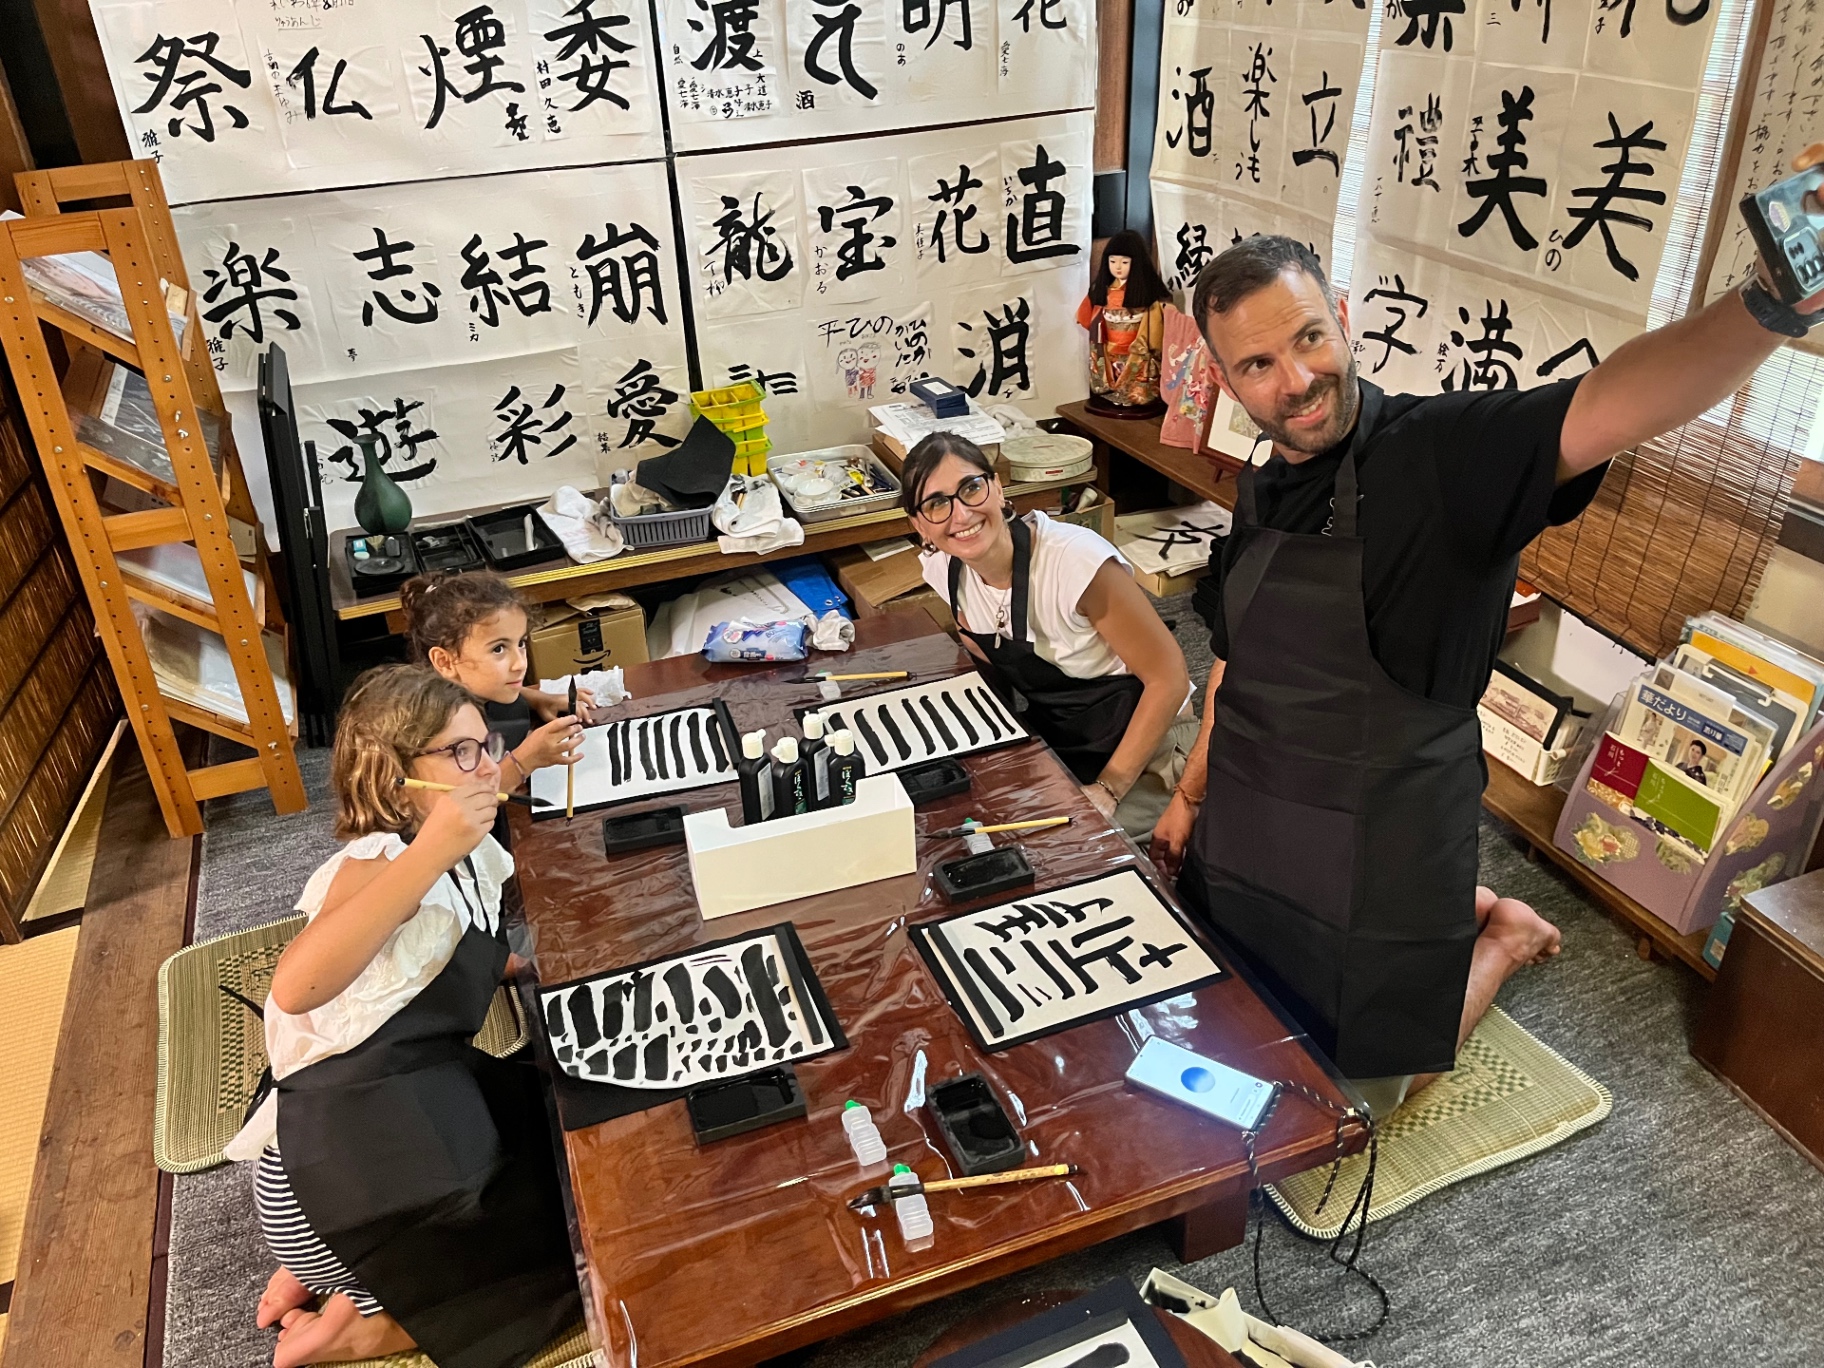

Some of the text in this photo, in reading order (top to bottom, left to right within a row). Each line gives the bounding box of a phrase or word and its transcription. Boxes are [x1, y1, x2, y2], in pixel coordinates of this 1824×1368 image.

[131, 31, 251, 142] 祭
[286, 46, 373, 120] 仏
[418, 5, 526, 130] 煙
[544, 0, 637, 111] 委
[1166, 66, 1215, 157] 酒
[1292, 71, 1344, 178] 立
[928, 165, 990, 263] 花
[1006, 144, 1083, 264] 直
[1458, 86, 1548, 251] 美
[1562, 111, 1668, 282] 美
[353, 227, 442, 327] 志
[460, 233, 552, 328] 結
[576, 222, 669, 328] 崩
[818, 186, 897, 281] 宝
[202, 241, 302, 344] 楽
[1363, 274, 1429, 374] 字
[956, 296, 1031, 399] 消
[1440, 298, 1524, 391] 満
[493, 383, 578, 465] 彩
[606, 358, 683, 450] 愛
